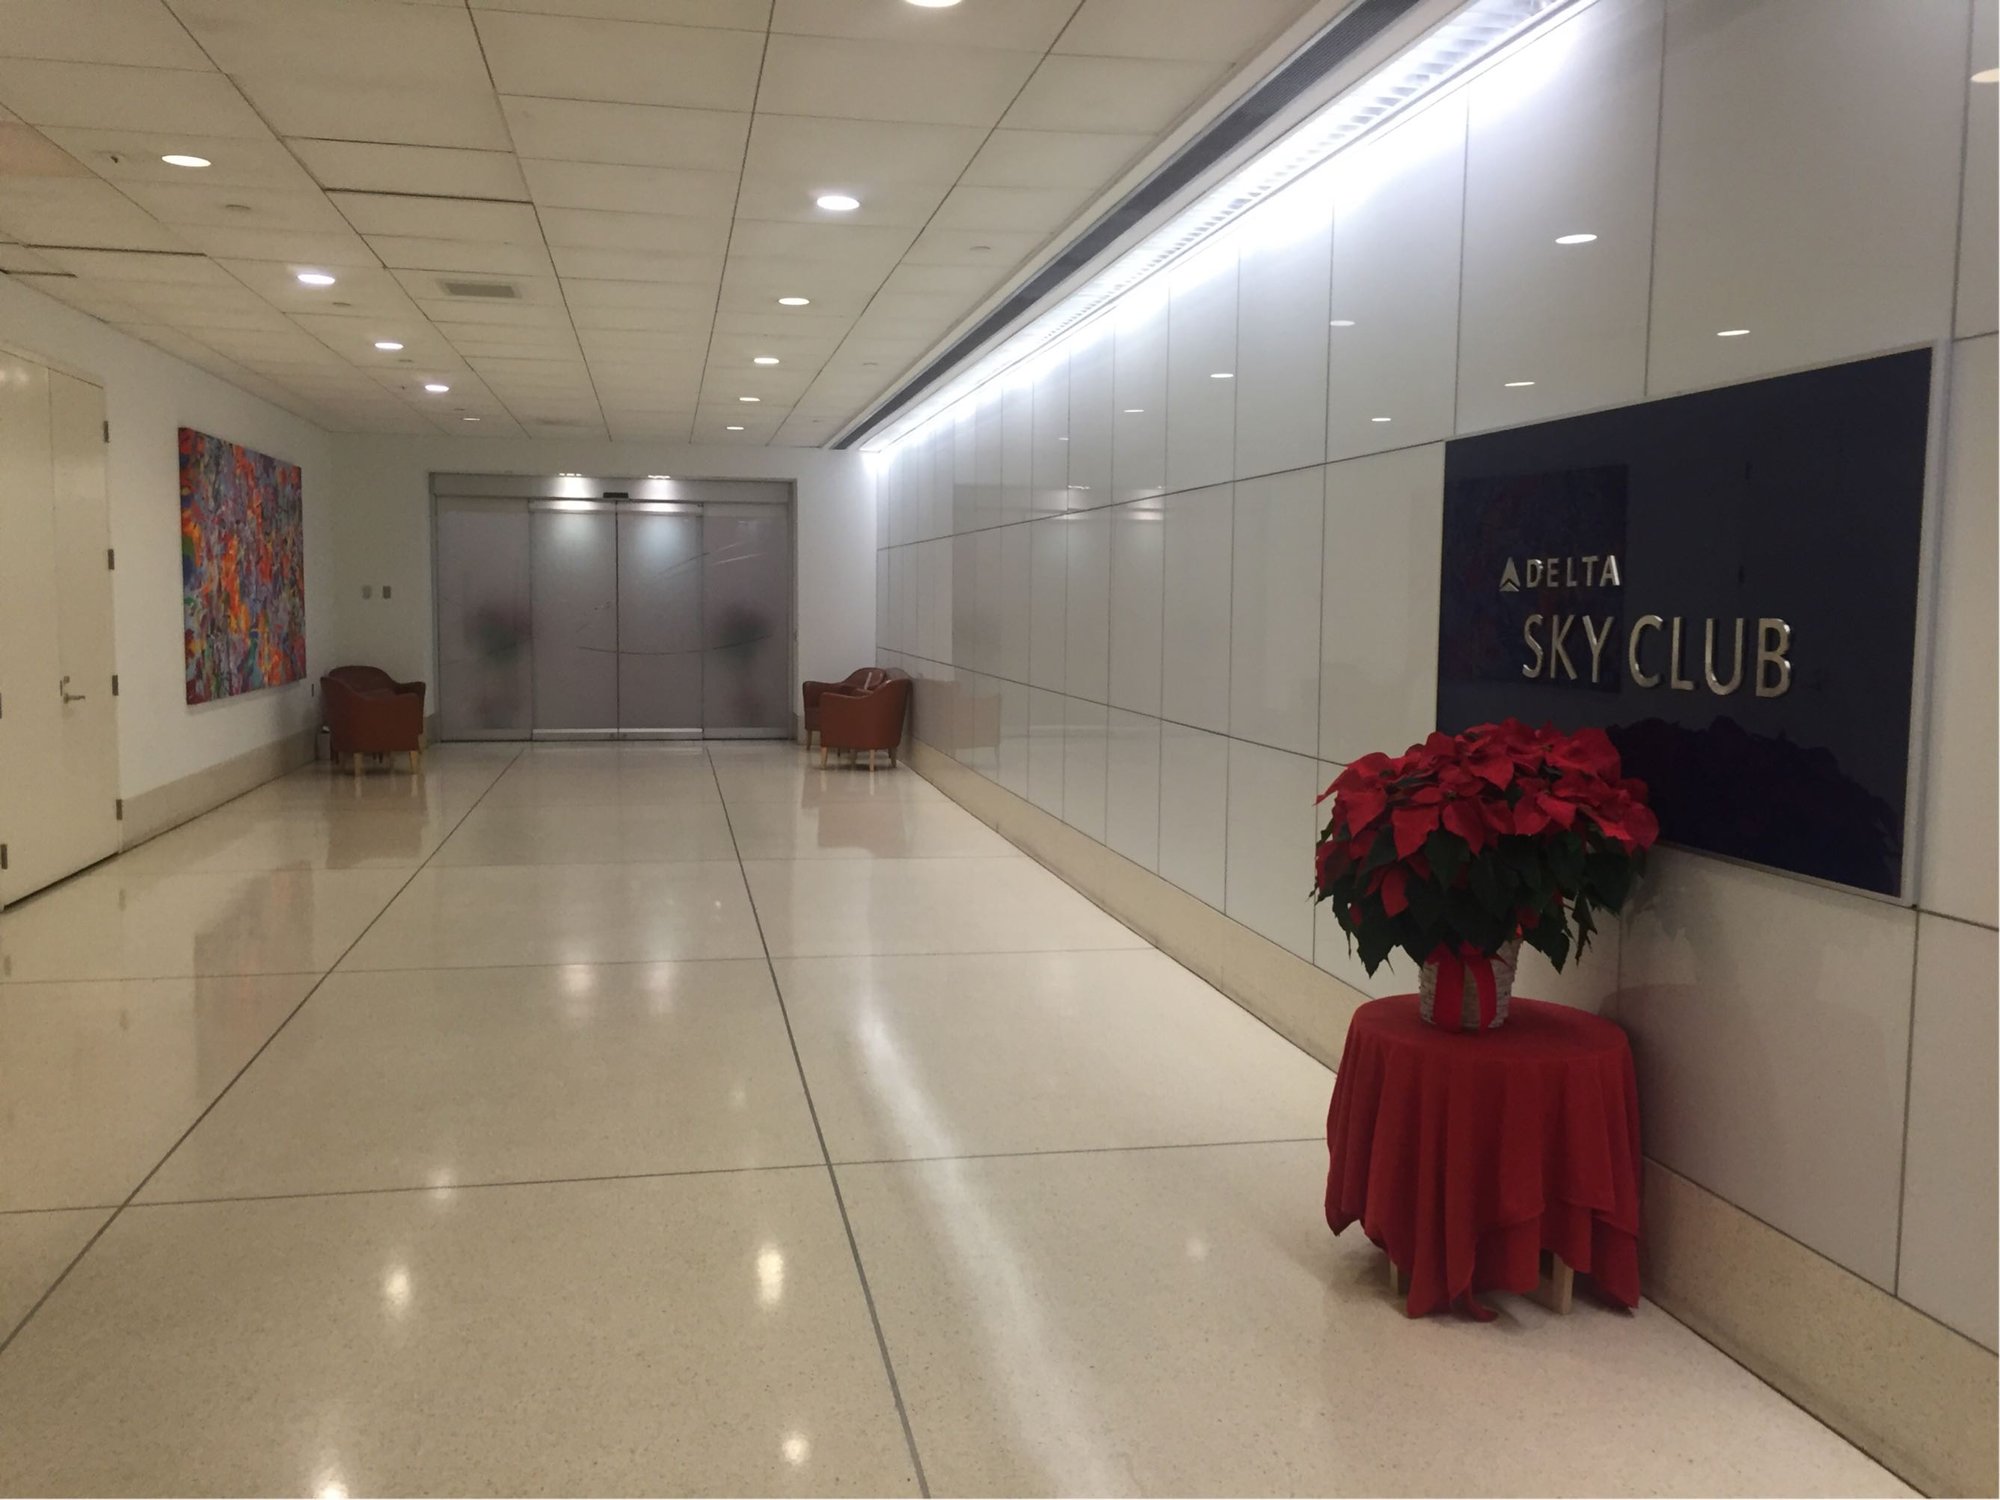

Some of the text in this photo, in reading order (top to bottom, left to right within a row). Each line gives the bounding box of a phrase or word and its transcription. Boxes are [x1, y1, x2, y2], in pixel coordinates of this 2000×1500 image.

[1526, 555, 1621, 588] DELTA
[1522, 614, 1792, 698] SKY CLUB
